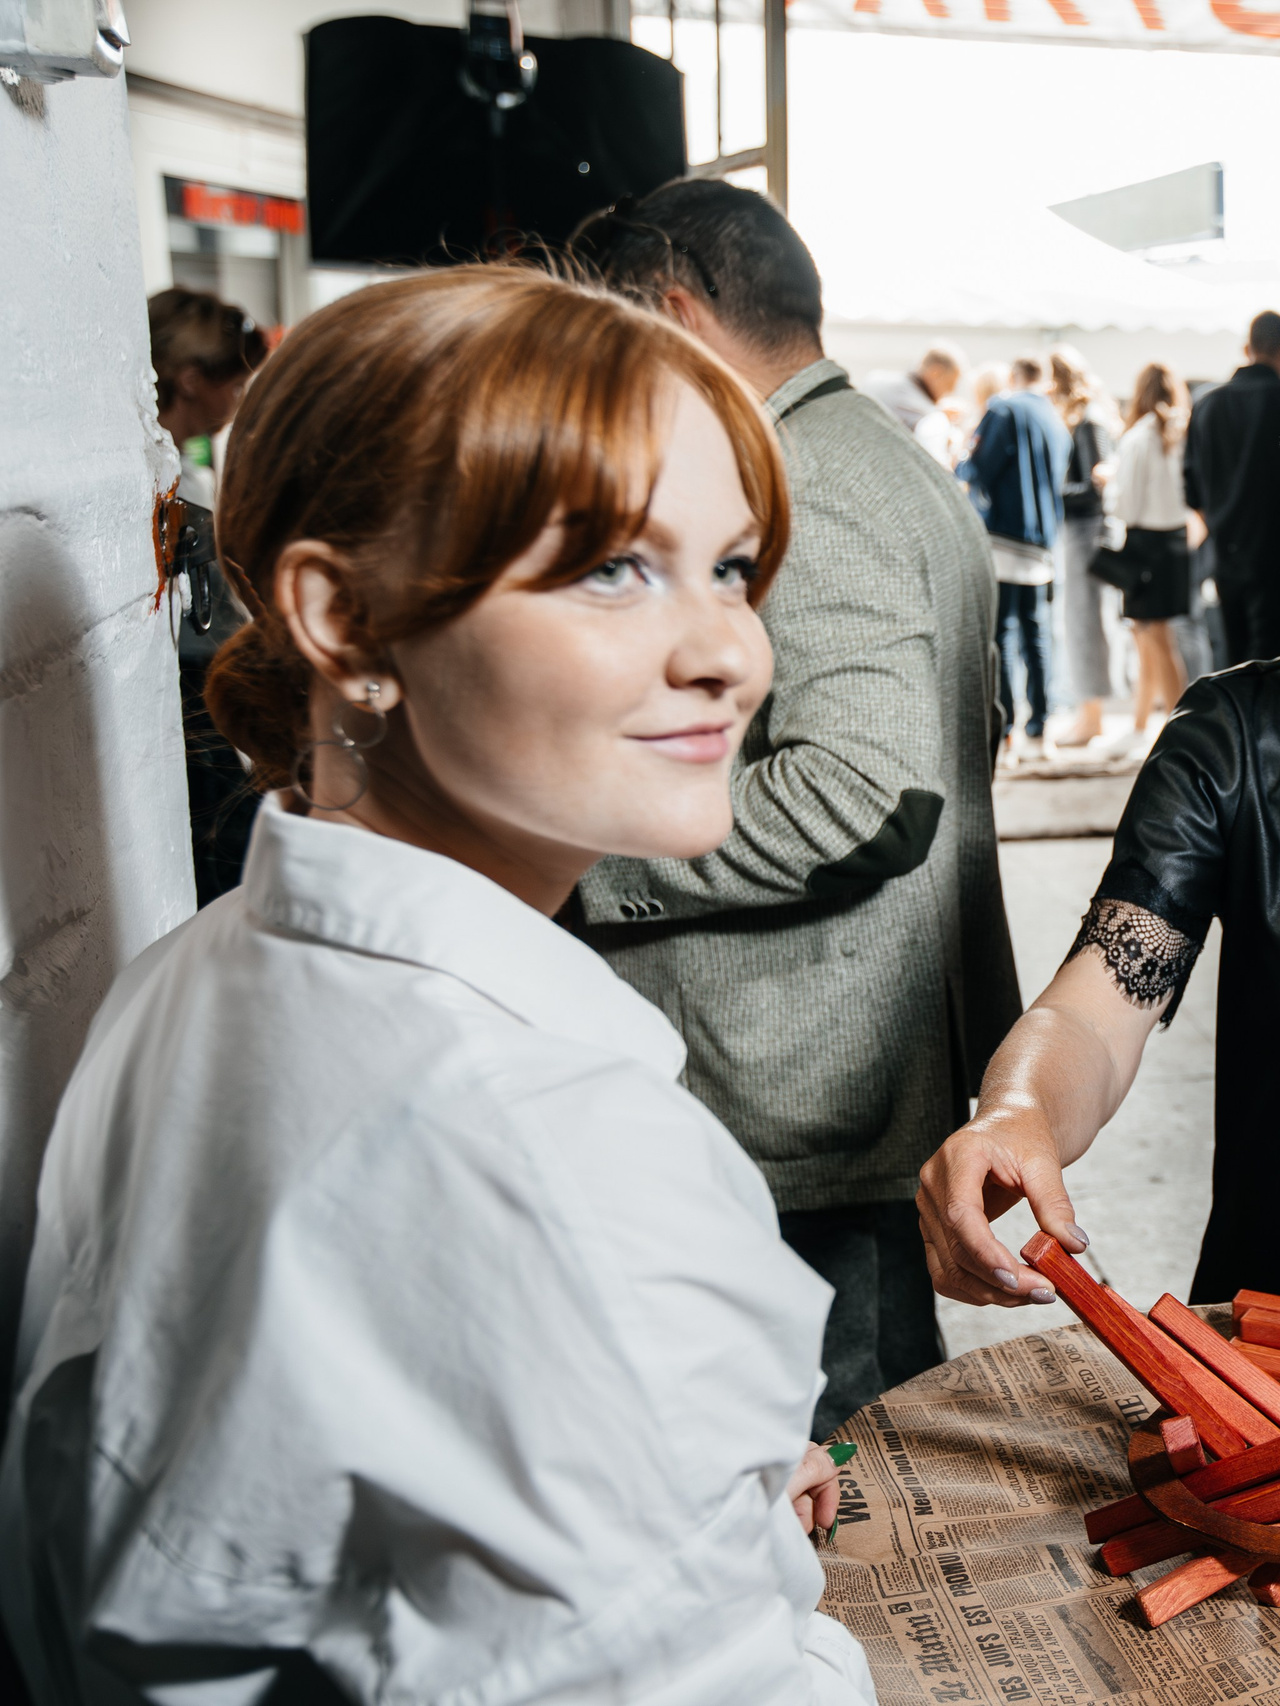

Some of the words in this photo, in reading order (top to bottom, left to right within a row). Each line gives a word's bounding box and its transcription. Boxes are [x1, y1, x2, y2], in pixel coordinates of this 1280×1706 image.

[1063, 1343, 1085, 1362] JOBS
[1080, 1369, 1106, 1401] RATED
[1008, 1402, 1024, 1417] After
[883, 1430, 903, 1451] into
[890, 1453, 913, 1475] look
[996, 1448, 1014, 1469] rights
[904, 1476, 922, 1485] to
[1005, 1469, 1031, 1507] Constitute
[1018, 1467, 1045, 1503] northeast
[908, 1485, 933, 1514] Need
[925, 1531, 937, 1549] News
[934, 1531, 948, 1547] Brief
[959, 1604, 992, 1626] EST
[1032, 1614, 1065, 1648] ANGLAIS
[975, 1634, 1013, 1666] JUIFS
[1056, 1649, 1072, 1664] AUX
[997, 1676, 1032, 1701] DES
[1053, 1680, 1069, 1690] DE
[1063, 1668, 1088, 1693] DAKAR
